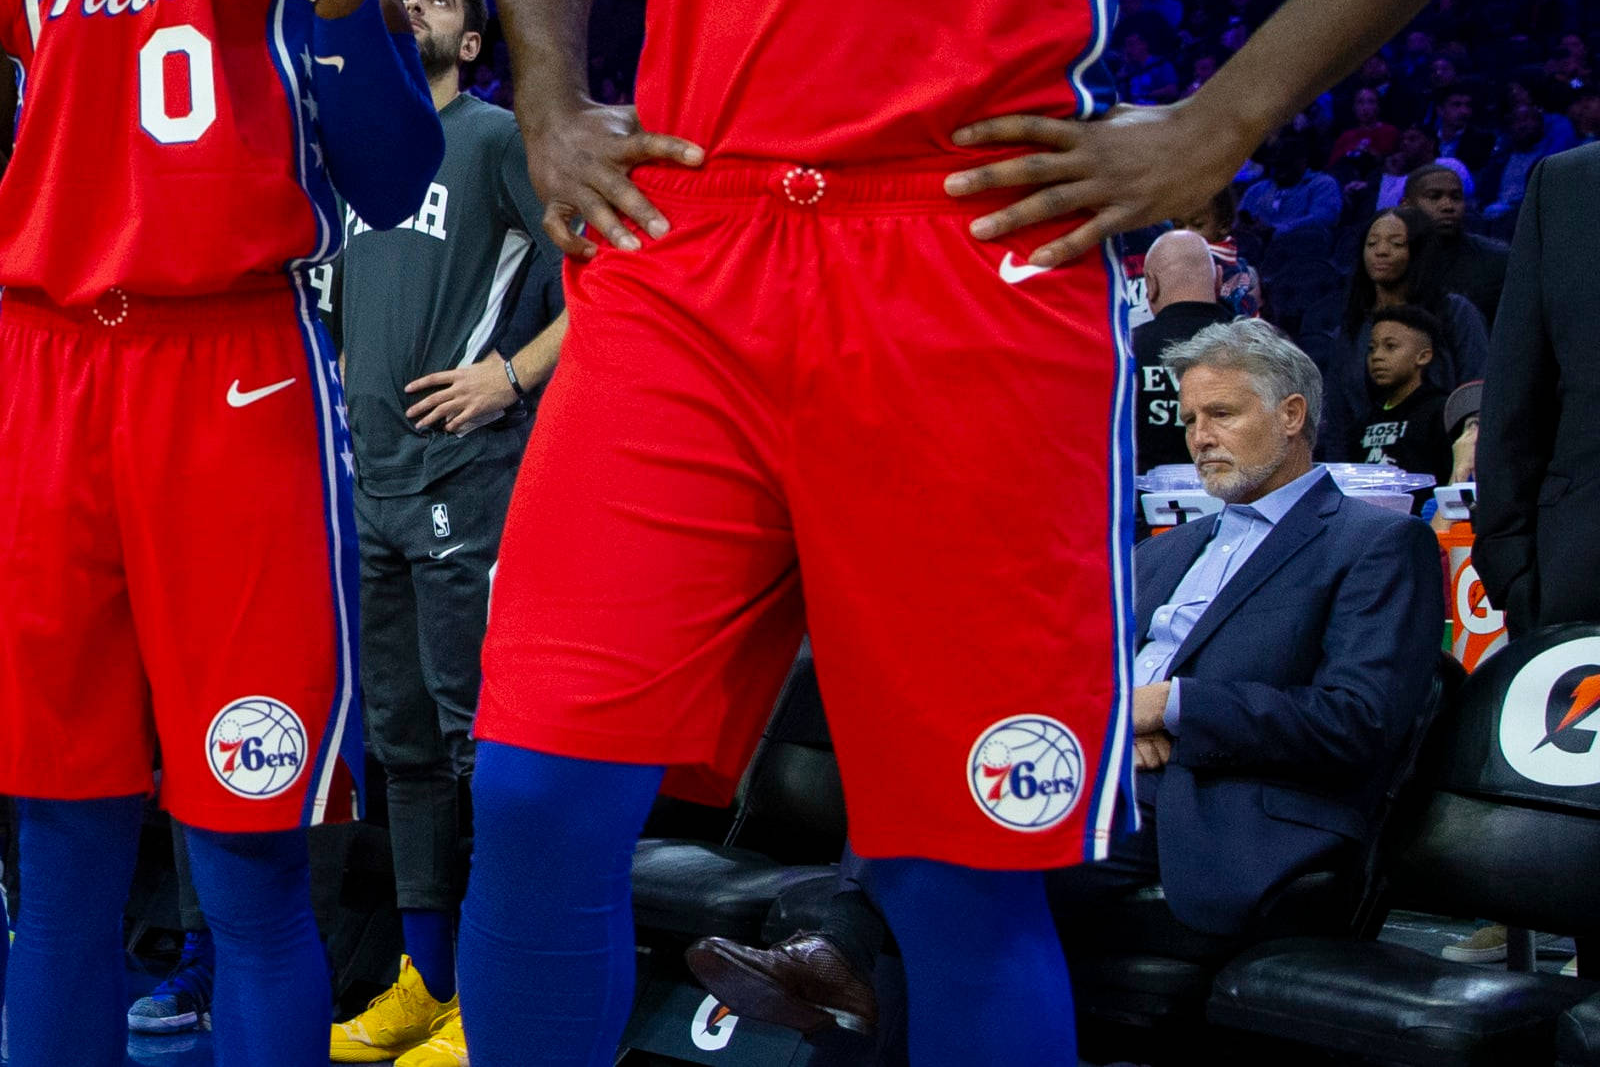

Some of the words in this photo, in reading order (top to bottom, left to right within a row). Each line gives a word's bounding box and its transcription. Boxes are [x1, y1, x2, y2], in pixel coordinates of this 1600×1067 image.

[139, 24, 216, 145] 0
[218, 736, 299, 773] 76ers
[982, 760, 1075, 801] 76ers
